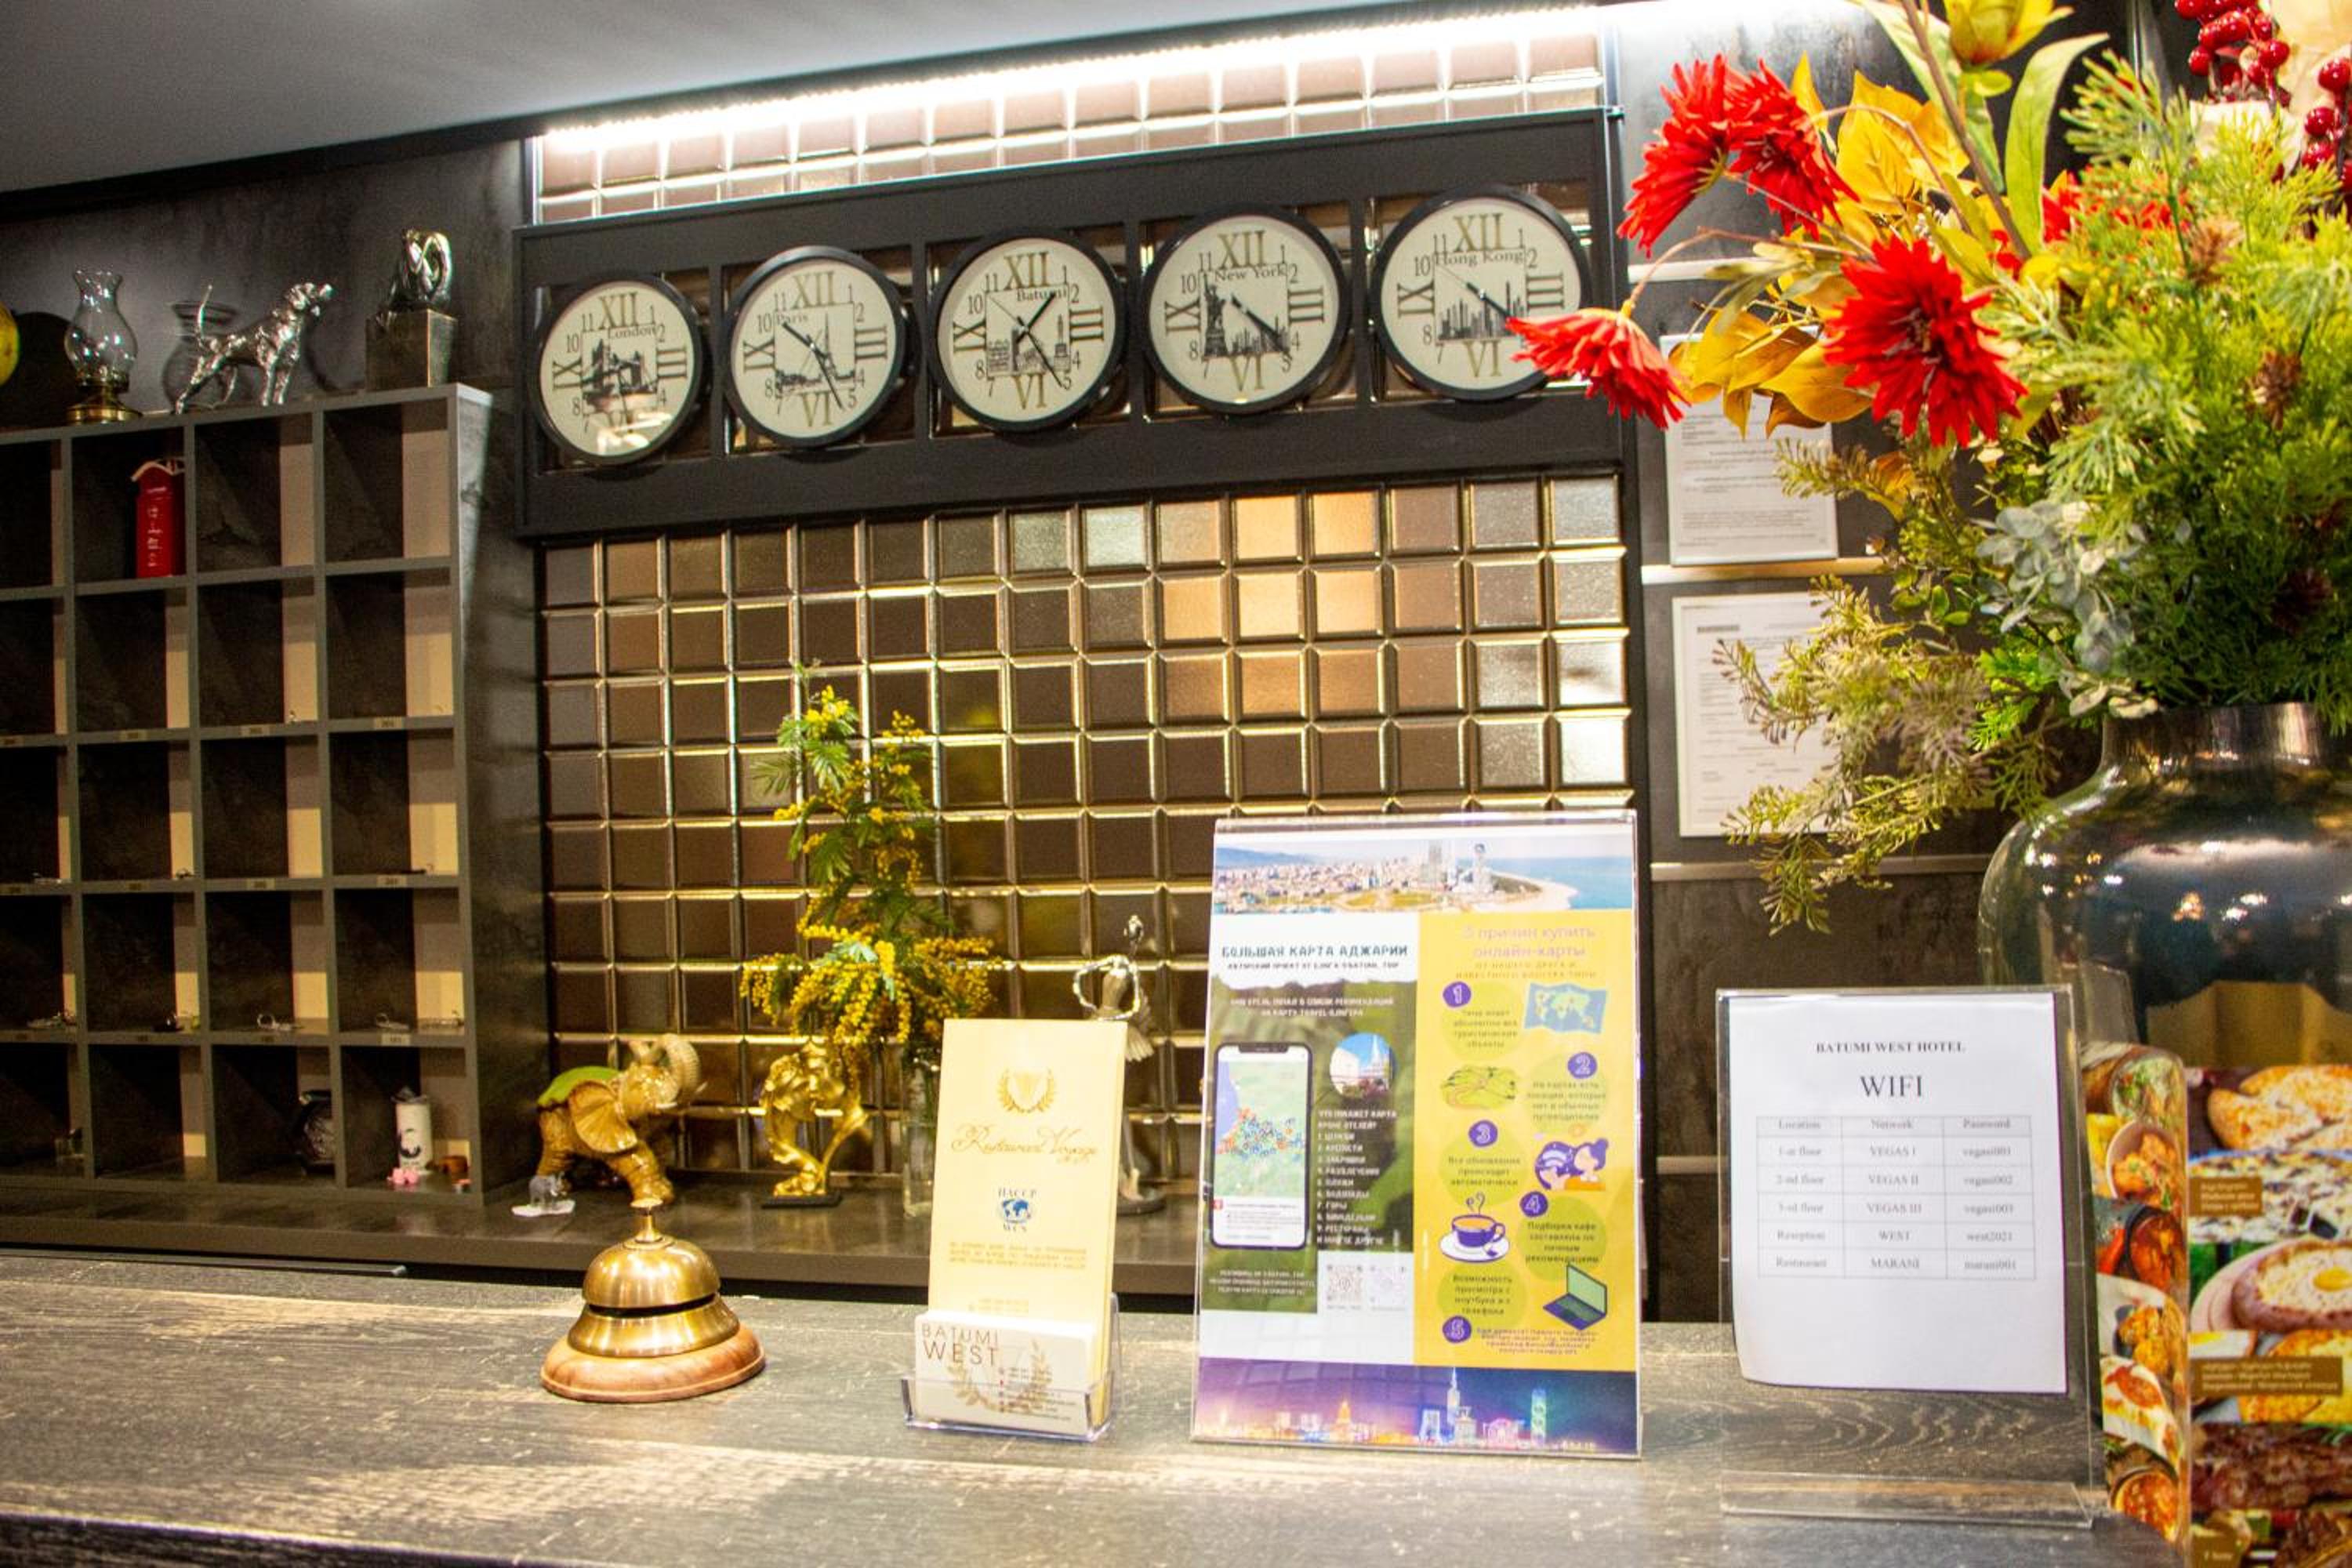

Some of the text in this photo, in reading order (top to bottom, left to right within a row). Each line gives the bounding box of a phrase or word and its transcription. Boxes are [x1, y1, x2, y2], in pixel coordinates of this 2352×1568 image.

[1453, 212, 1504, 252] XII
[1518, 228, 1524, 248] 1
[1218, 230, 1265, 270] XII
[1280, 245, 1286, 263] 1
[1433, 234, 1447, 256] 11
[1199, 251, 1213, 272] 11
[1414, 256, 1431, 276] 10
[1435, 249, 1526, 267] Hong Kong
[1527, 248, 1537, 268] 2
[1004, 251, 1050, 291] XII
[1063, 265, 1068, 284] 1
[1214, 264, 1287, 281] New York
[1290, 263, 1298, 284] 2
[793, 270, 834, 309] XII
[985, 274, 998, 292] 11
[1181, 274, 1197, 294] 10
[774, 292, 787, 312] 11
[848, 284, 854, 303] 1
[1072, 284, 1080, 303] 2
[598, 292, 639, 330] XII
[855, 303, 865, 323] 2
[967, 295, 983, 314] 10
[582, 314, 593, 332] 11
[650, 305, 655, 325] 1
[757, 314, 772, 333] 10
[776, 314, 808, 325] Paris
[608, 325, 656, 339] London
[659, 325, 666, 343] 2
[1292, 331, 1300, 350] 4
[1422, 325, 1432, 345] 8
[566, 333, 579, 353] 10
[1189, 339, 1199, 361] 8
[1073, 350, 1080, 369] 4
[1436, 343, 1444, 364] 7
[1463, 339, 1501, 378] VI
[975, 361, 985, 380] 8
[1229, 354, 1265, 392] VI
[764, 379, 773, 398] 8
[987, 376, 994, 397] 7
[1012, 373, 1047, 410] VI
[572, 397, 581, 416] 8
[801, 391, 834, 426] VI
[1221, 944, 1409, 958] БОЛЬШАЯ КАРТА АДЖАРИИ
[1816, 1040, 1966, 1054] BATUMI WEST HOTEL
[1574, 1057, 1591, 1076] 2
[1860, 1075, 1922, 1098] WIFI
[1869, 1145, 1910, 1156] VEGAS
[1868, 1174, 1908, 1186] VEGAS
[1525, 1194, 1541, 1214] 4
[1867, 1203, 1907, 1214] VEGAS
[921, 1323, 1000, 1345] BATUMI
[922, 1341, 1000, 1367] WEST
